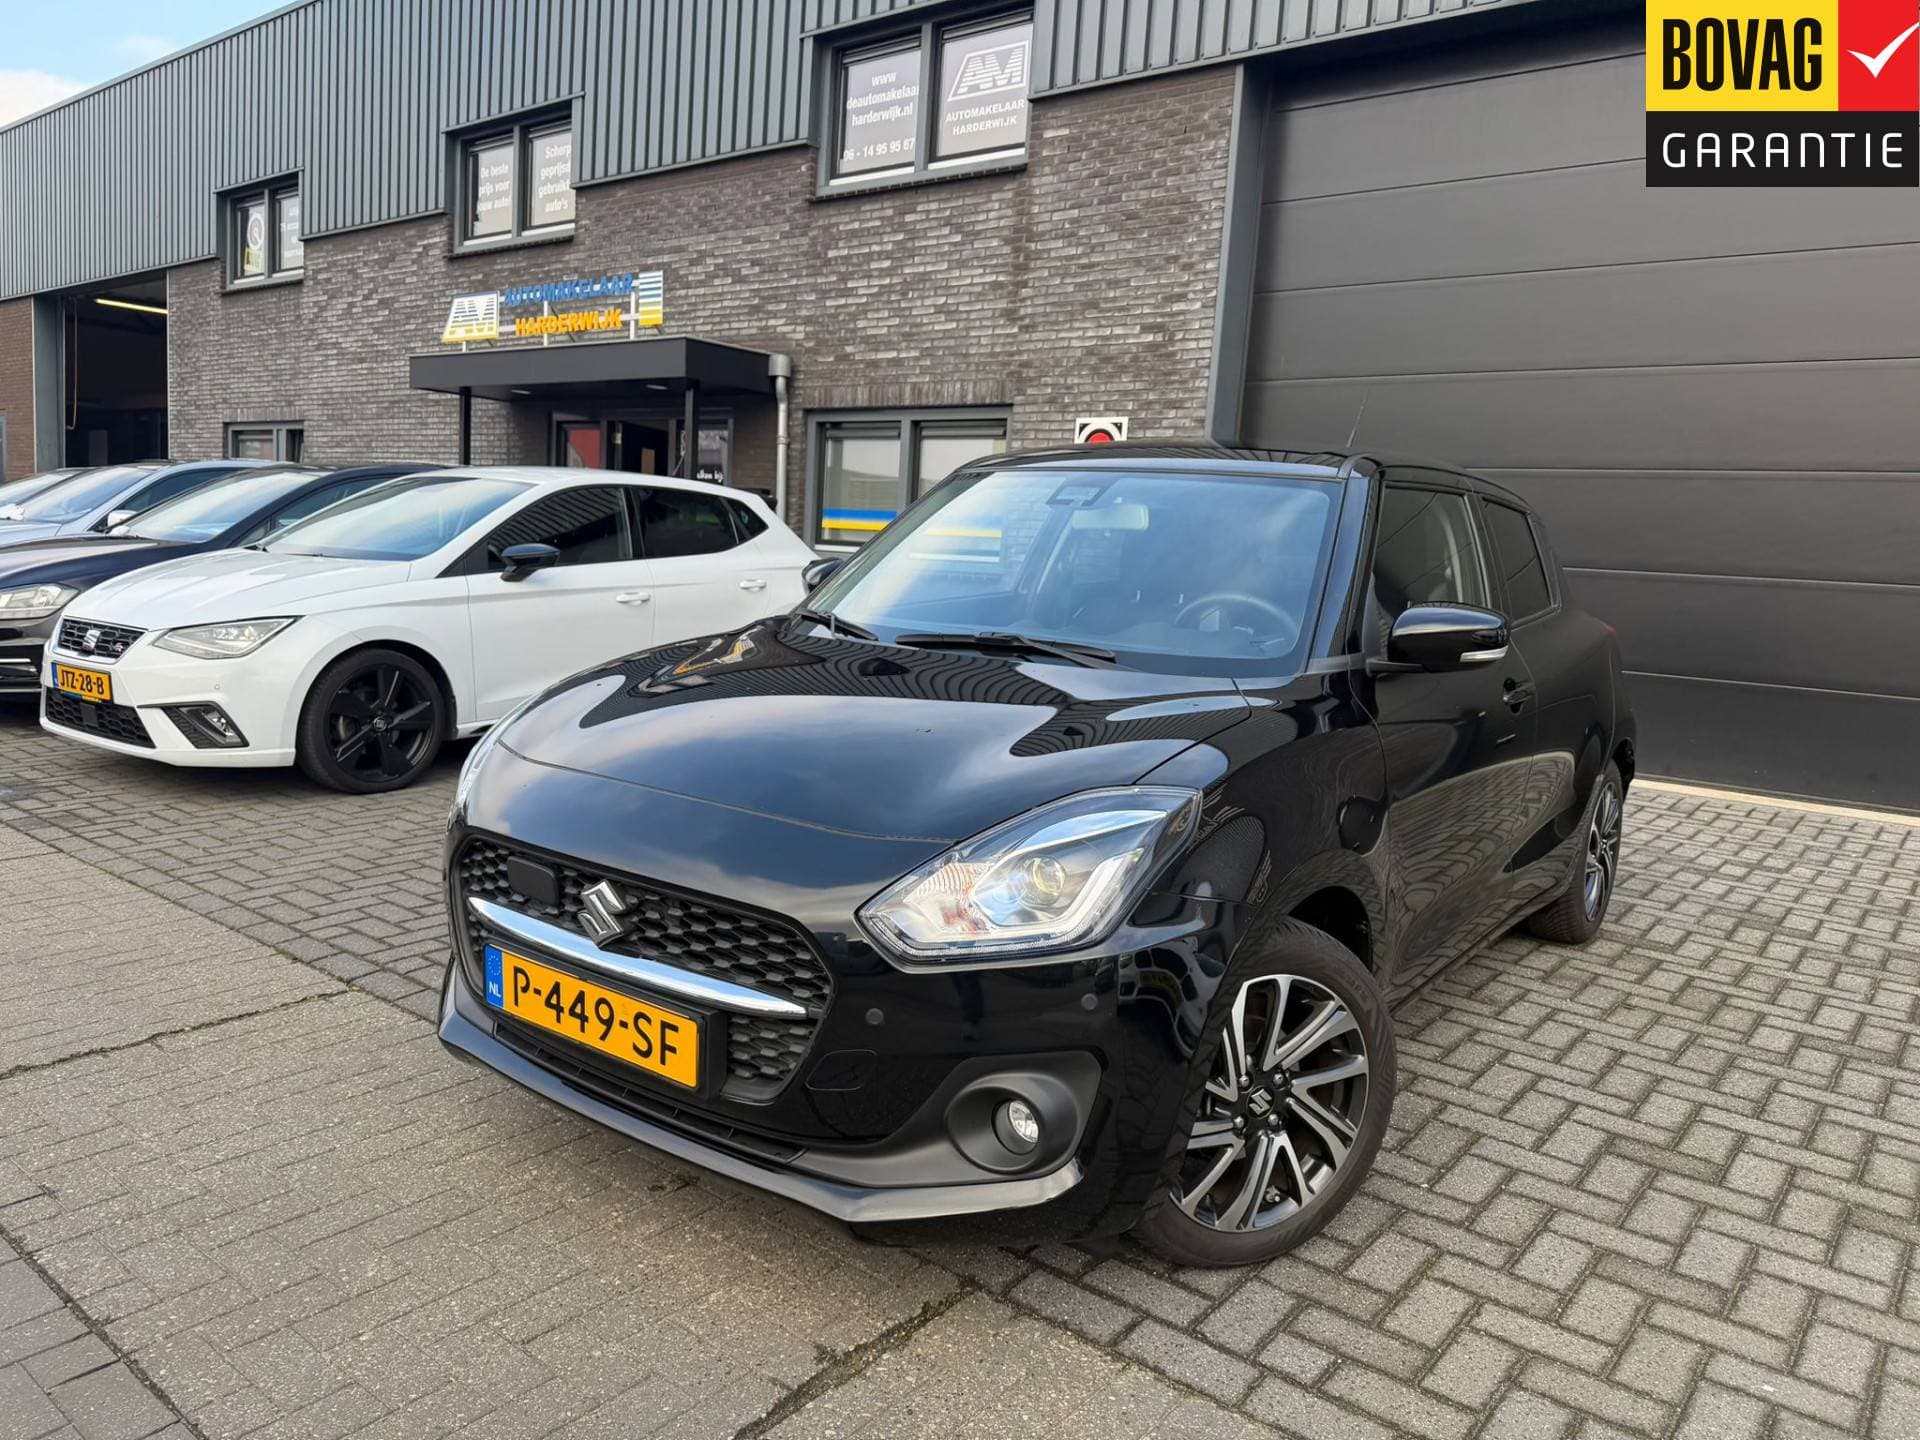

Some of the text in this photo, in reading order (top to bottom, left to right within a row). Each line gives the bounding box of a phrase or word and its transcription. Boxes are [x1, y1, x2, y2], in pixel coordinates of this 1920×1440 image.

[871, 71, 897, 86] www
[852, 103, 914, 127] harderwijk.nl
[945, 98, 1025, 123] AUTOMAKELAAR
[952, 115, 1017, 136] HARDERWIJK
[863, 145, 875, 158] 14
[889, 139, 901, 153] 95
[504, 272, 635, 307] AUTOMAKELAAR
[515, 308, 624, 337] HARDERWIJK
[60, 669, 105, 695] JTZ-28-B
[489, 981, 502, 998] NL
[513, 965, 679, 1066] P-449-SF
